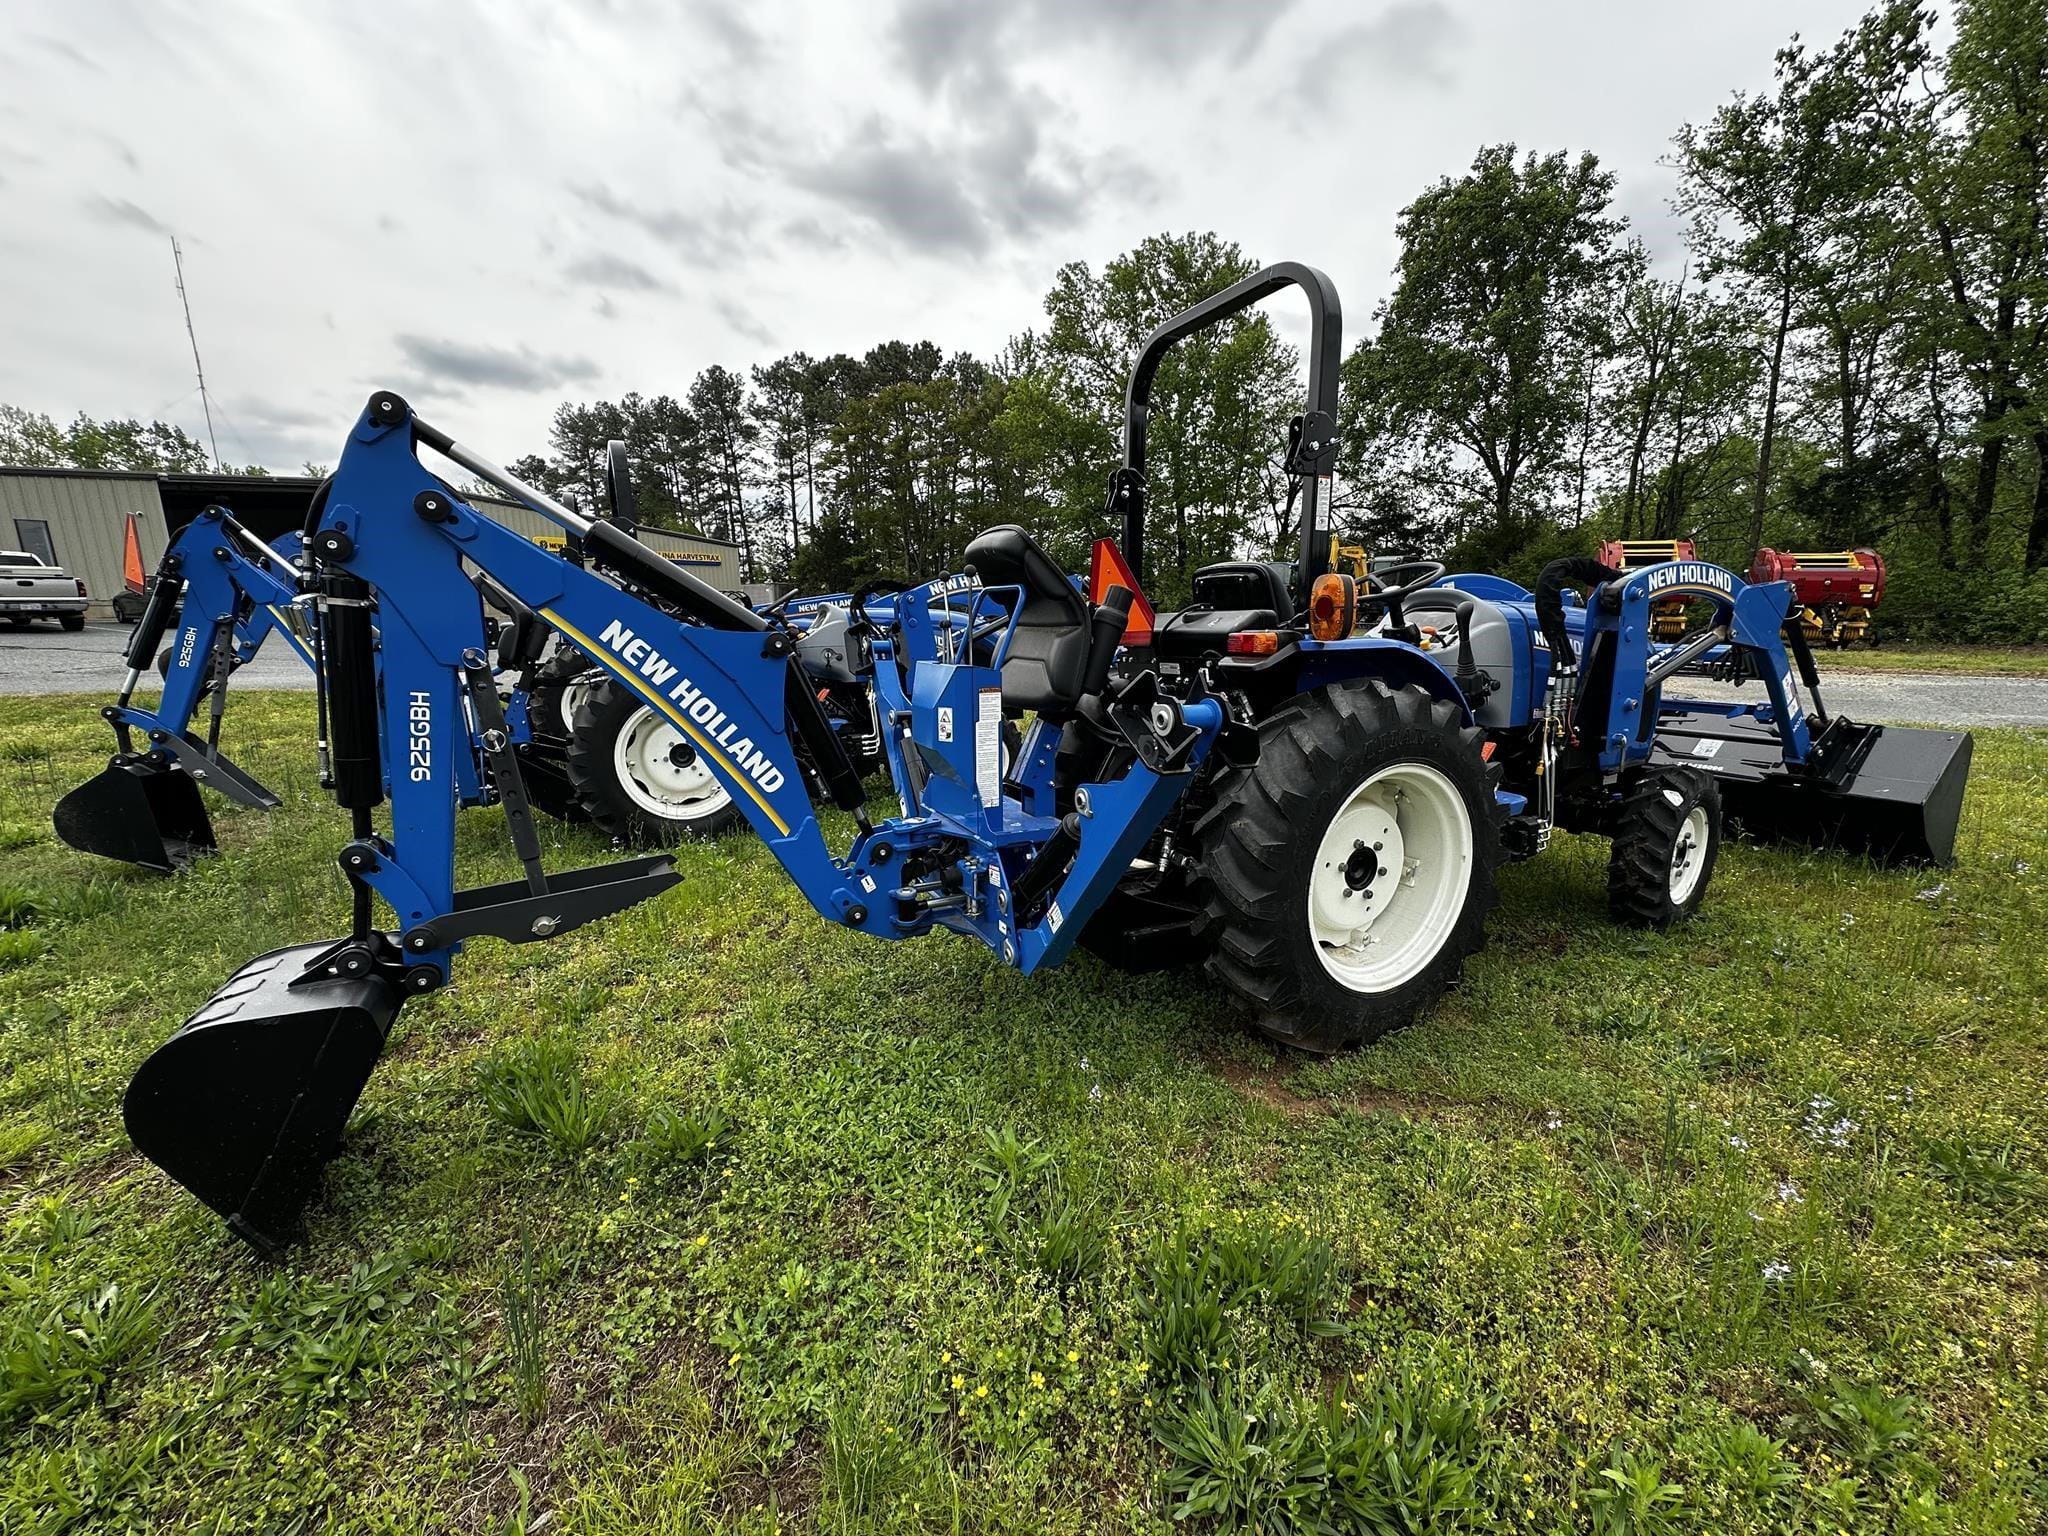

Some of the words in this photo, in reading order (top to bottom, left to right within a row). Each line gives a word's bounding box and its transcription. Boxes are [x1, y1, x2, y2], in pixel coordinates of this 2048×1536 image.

[677, 553, 720, 562] HARVESTRAX
[1648, 566, 1677, 592] NEW
[1680, 564, 1732, 593] HOLLAND
[798, 603, 818, 613] NEW
[179, 626, 198, 668] 925GBH
[598, 619, 679, 686] NEW
[668, 678, 785, 793] HOLLAND
[409, 691, 431, 782] 925GBH
